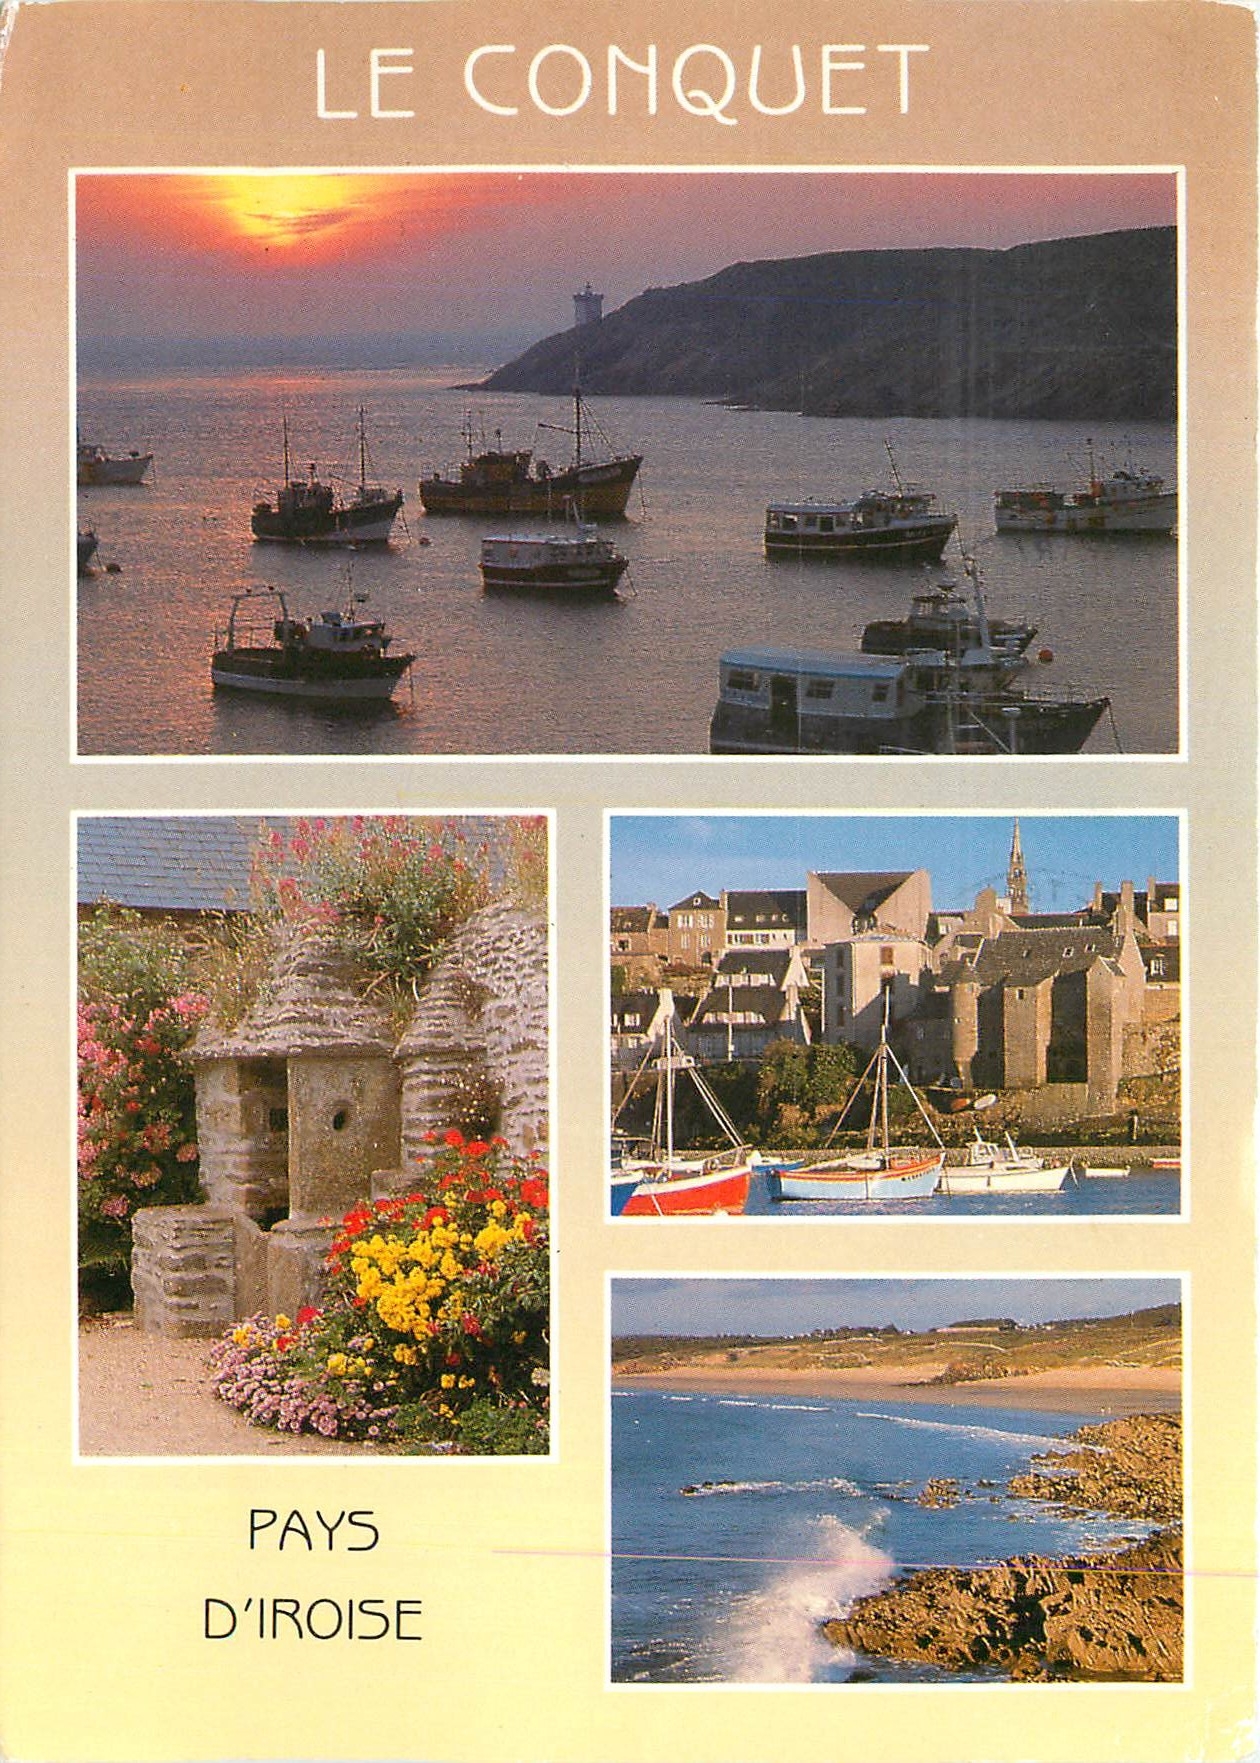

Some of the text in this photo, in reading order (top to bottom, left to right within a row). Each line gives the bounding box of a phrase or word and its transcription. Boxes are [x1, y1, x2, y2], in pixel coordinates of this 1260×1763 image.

[316, 43, 931, 126] LE CONQUET
[249, 1508, 380, 1552] PAYS
[203, 1597, 423, 1641] D'IROISE
